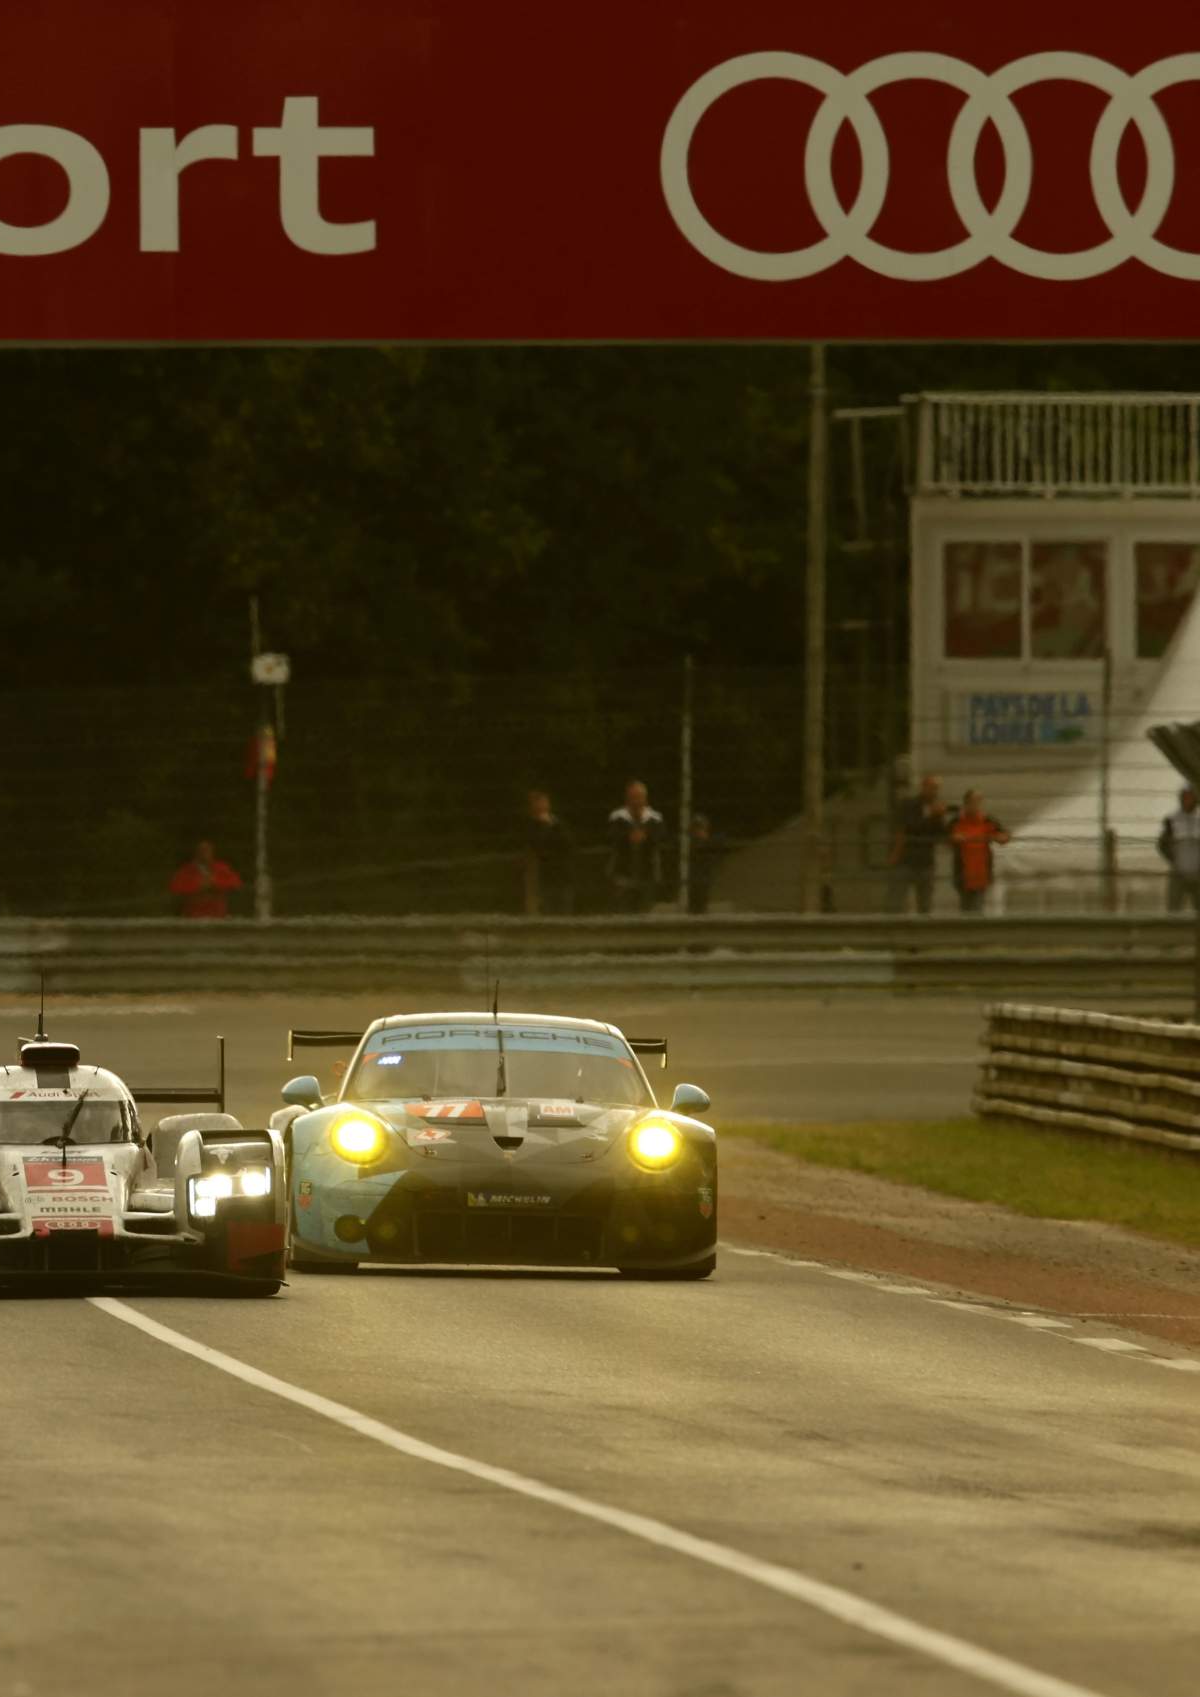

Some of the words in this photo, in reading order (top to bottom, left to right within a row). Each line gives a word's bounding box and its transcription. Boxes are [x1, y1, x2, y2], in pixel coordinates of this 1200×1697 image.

[382, 1029, 613, 1049] PORSCHE
[423, 1103, 469, 1118] 77
[47, 1168, 85, 1186] 9
[52, 1195, 113, 1203] BOSCH
[40, 1206, 102, 1214] MAHLE
